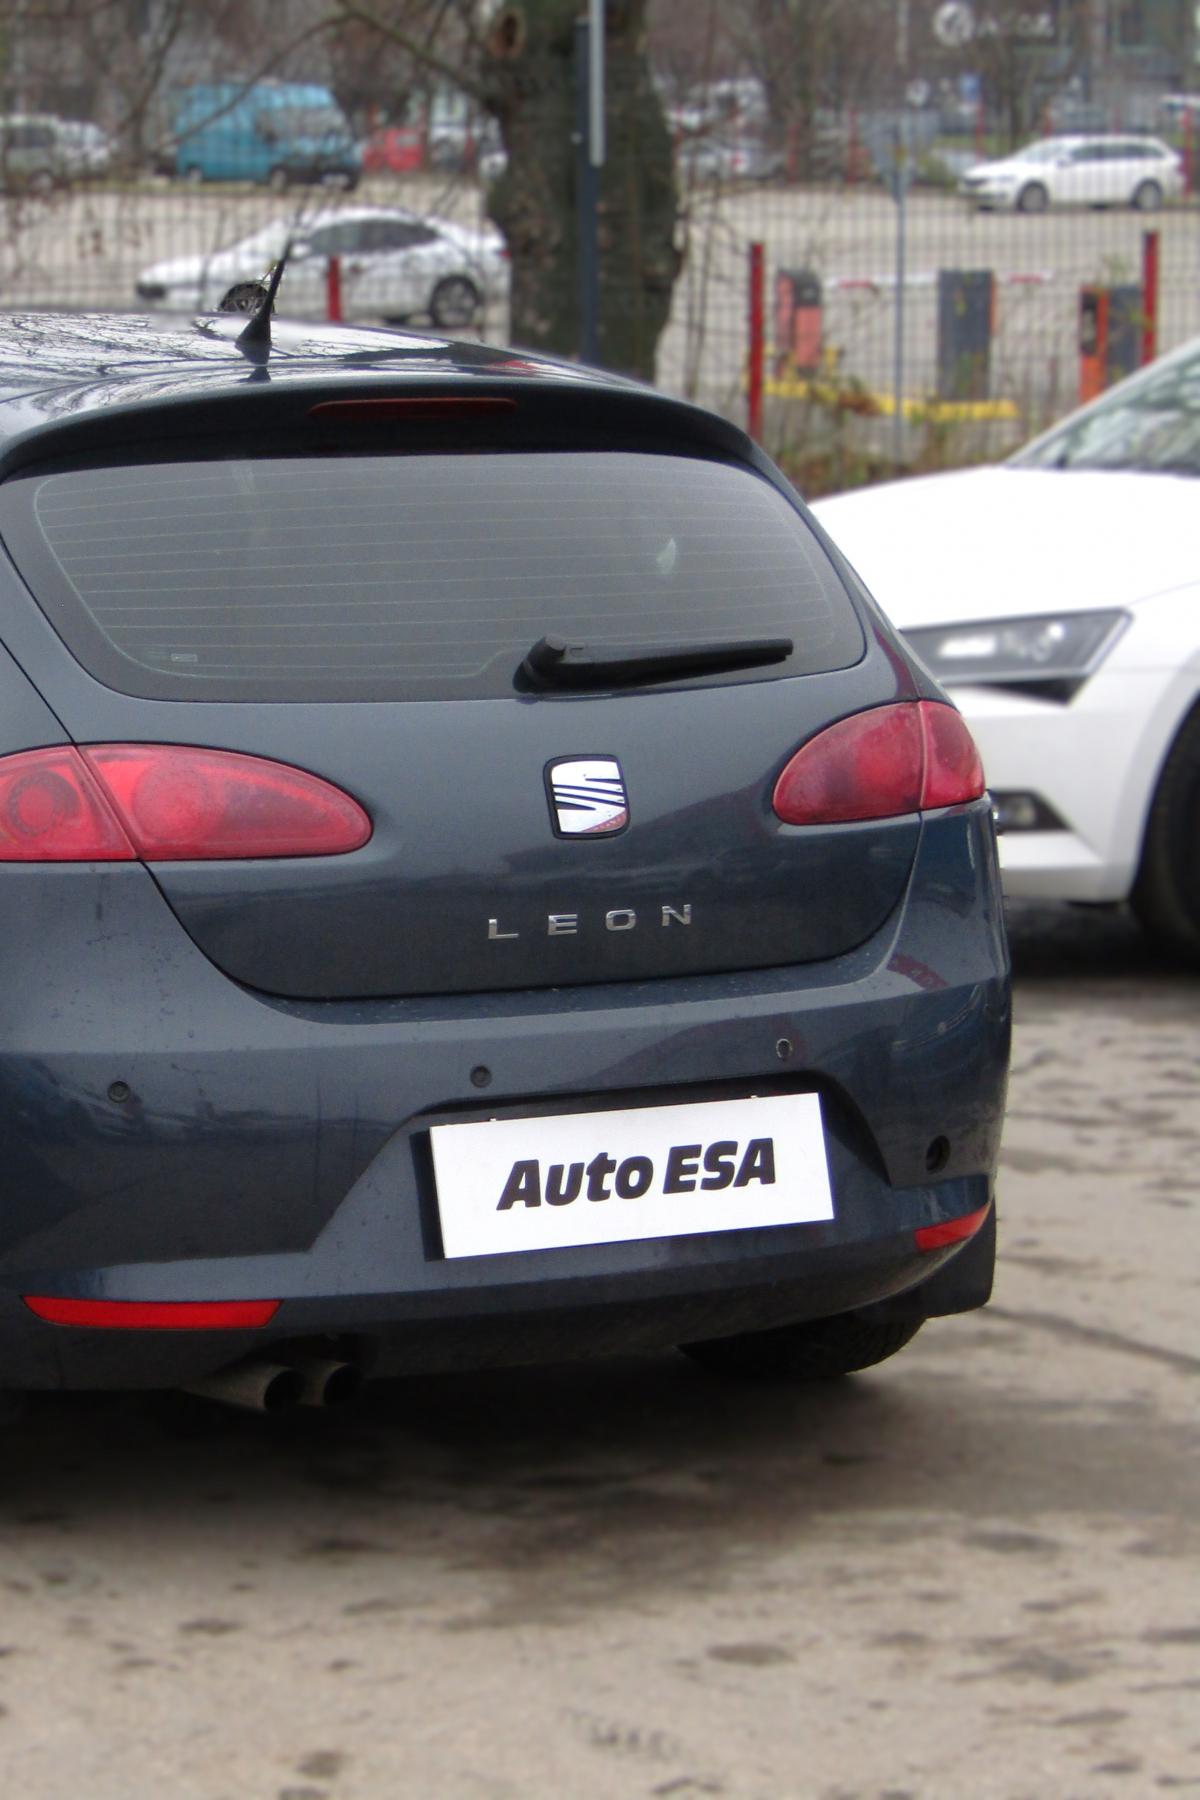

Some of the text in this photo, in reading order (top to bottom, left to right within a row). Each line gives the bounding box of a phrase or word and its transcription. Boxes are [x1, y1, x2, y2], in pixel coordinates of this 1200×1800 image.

[488, 904, 692, 939] LEON
[497, 1137, 776, 1210] Auto ESA
